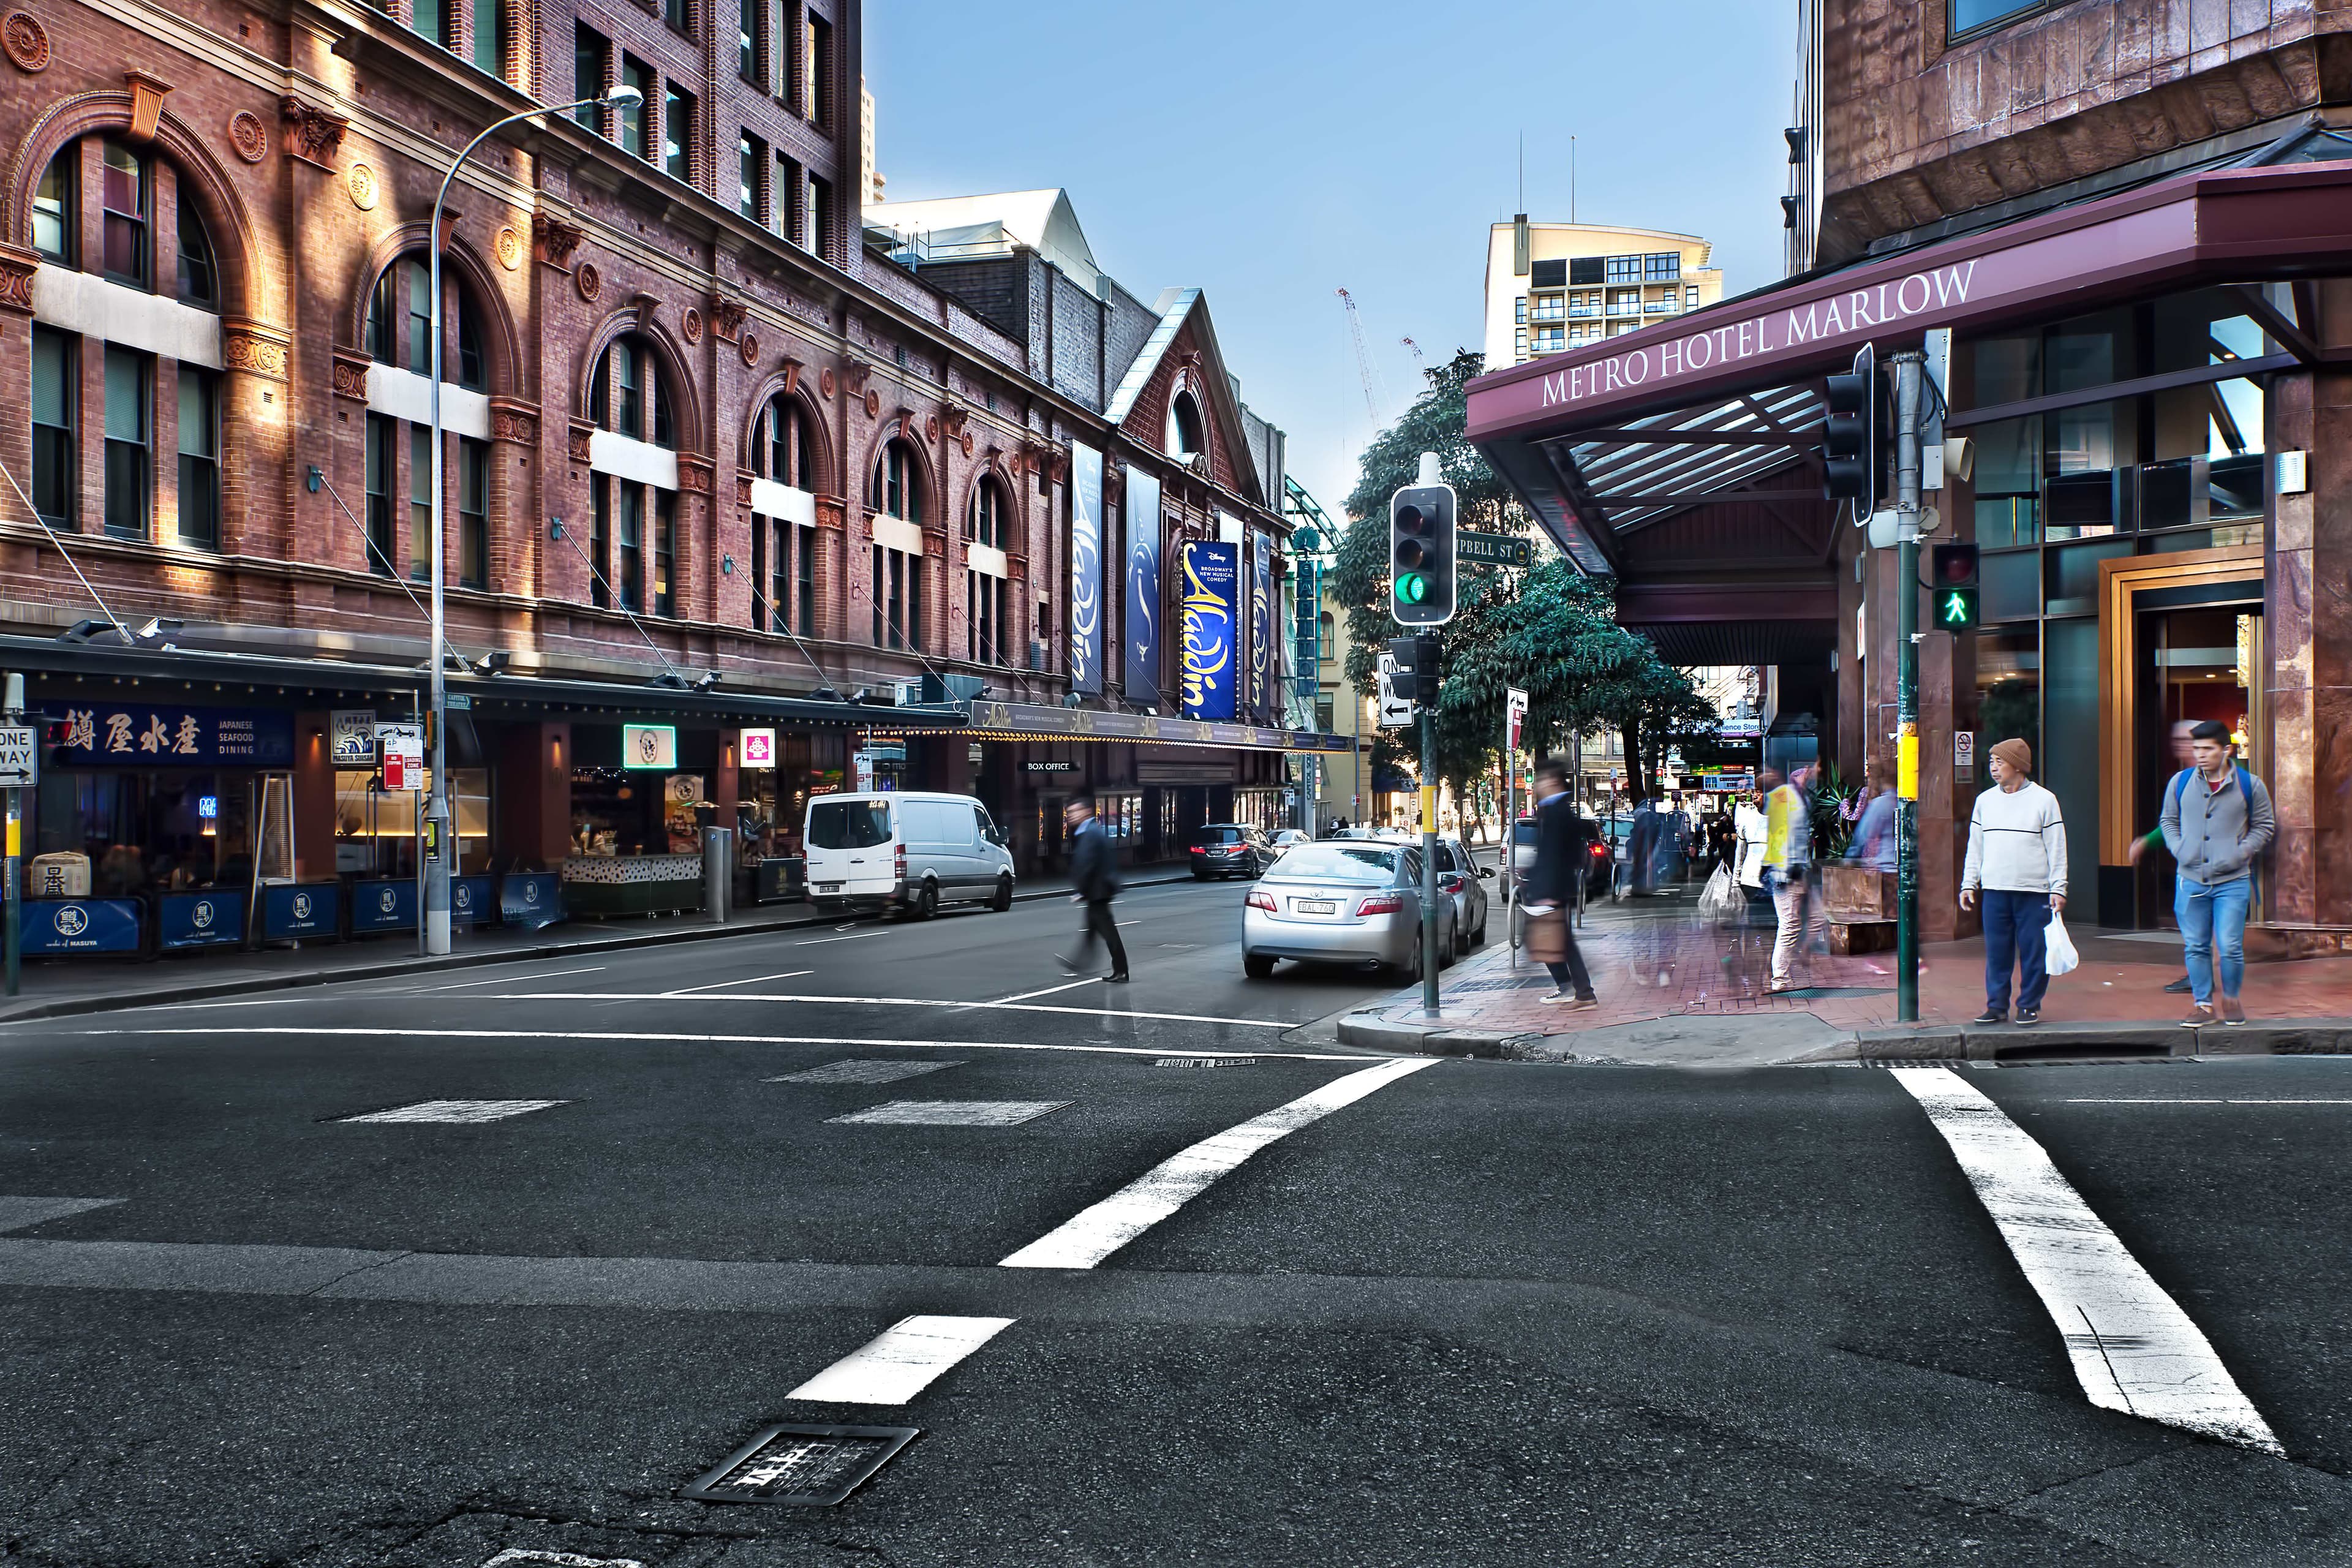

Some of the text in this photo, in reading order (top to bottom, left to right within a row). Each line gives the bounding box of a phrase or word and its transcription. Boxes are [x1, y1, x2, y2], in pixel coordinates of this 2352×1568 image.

[1542, 260, 1978, 407] METRO HOTEL MARLOW
[1457, 539, 1512, 558] PBELL ST
[1207, 552, 1226, 563] Disney
[1183, 543, 1228, 707] Aladdin
[1298, 562, 1314, 695] CAPITOL
[219, 721, 253, 729] JAPANESE
[219, 733, 254, 742] SEAFOOD
[219, 745, 254, 754] DINING
